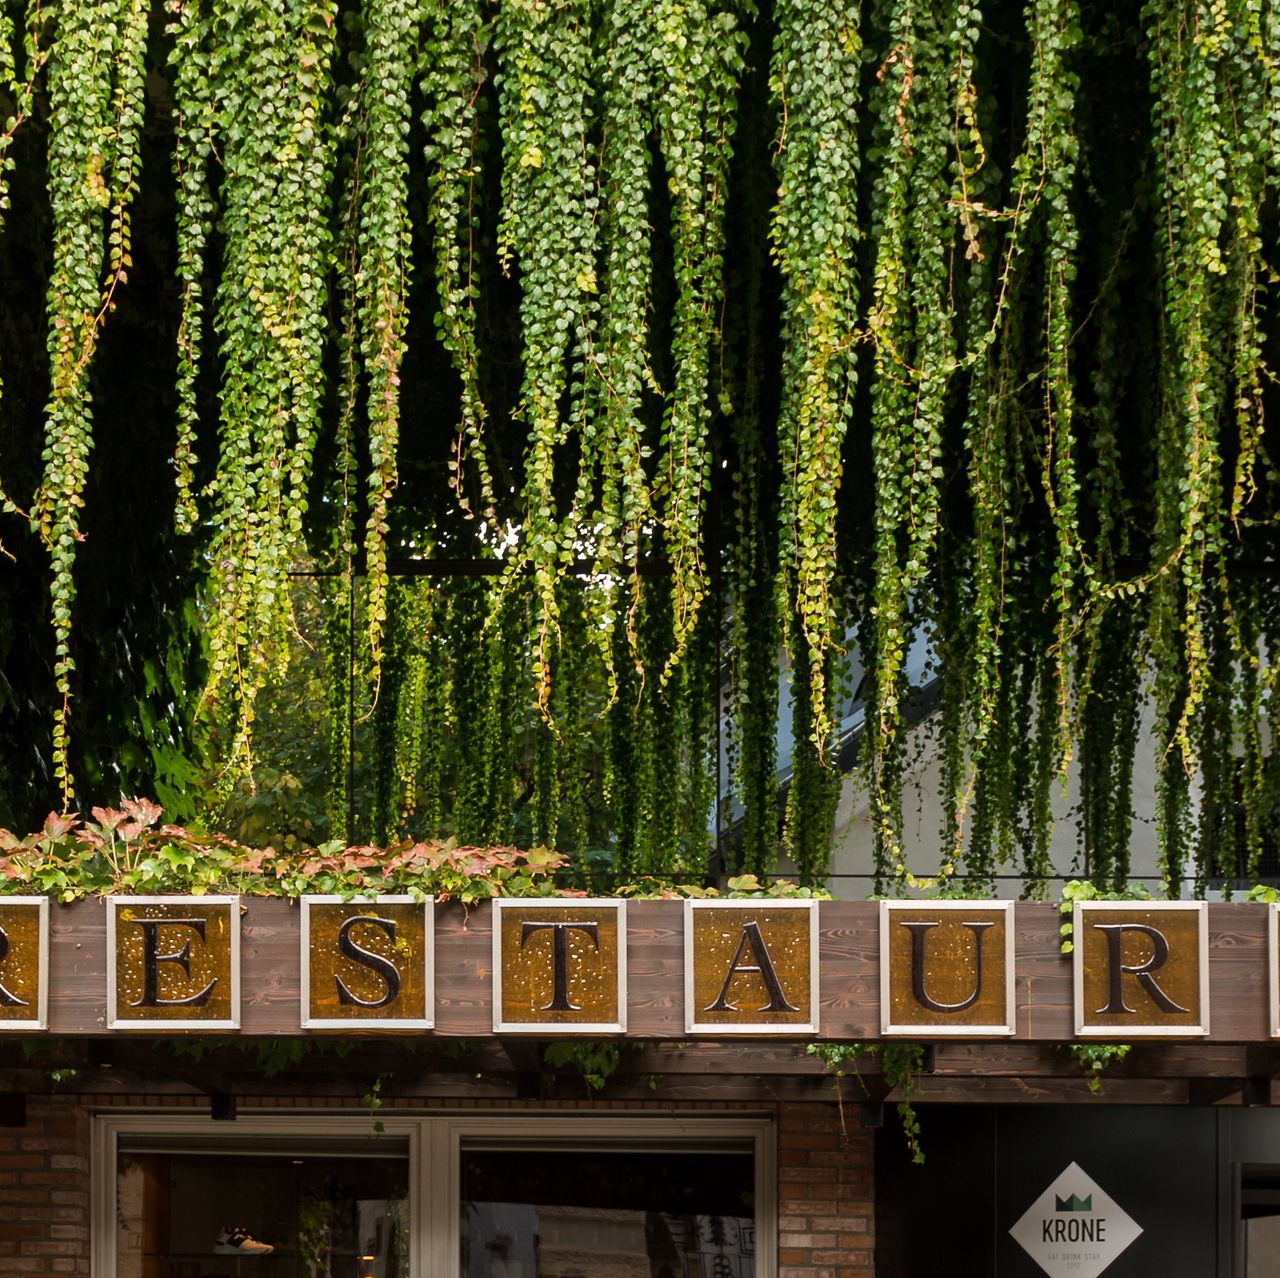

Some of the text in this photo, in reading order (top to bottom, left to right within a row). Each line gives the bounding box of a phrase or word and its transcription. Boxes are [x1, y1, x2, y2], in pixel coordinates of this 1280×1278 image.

[1042, 1218, 1107, 1242] KRONE
[1062, 1252, 1081, 1261] DRINK
[1084, 1252, 1101, 1261] STAY
